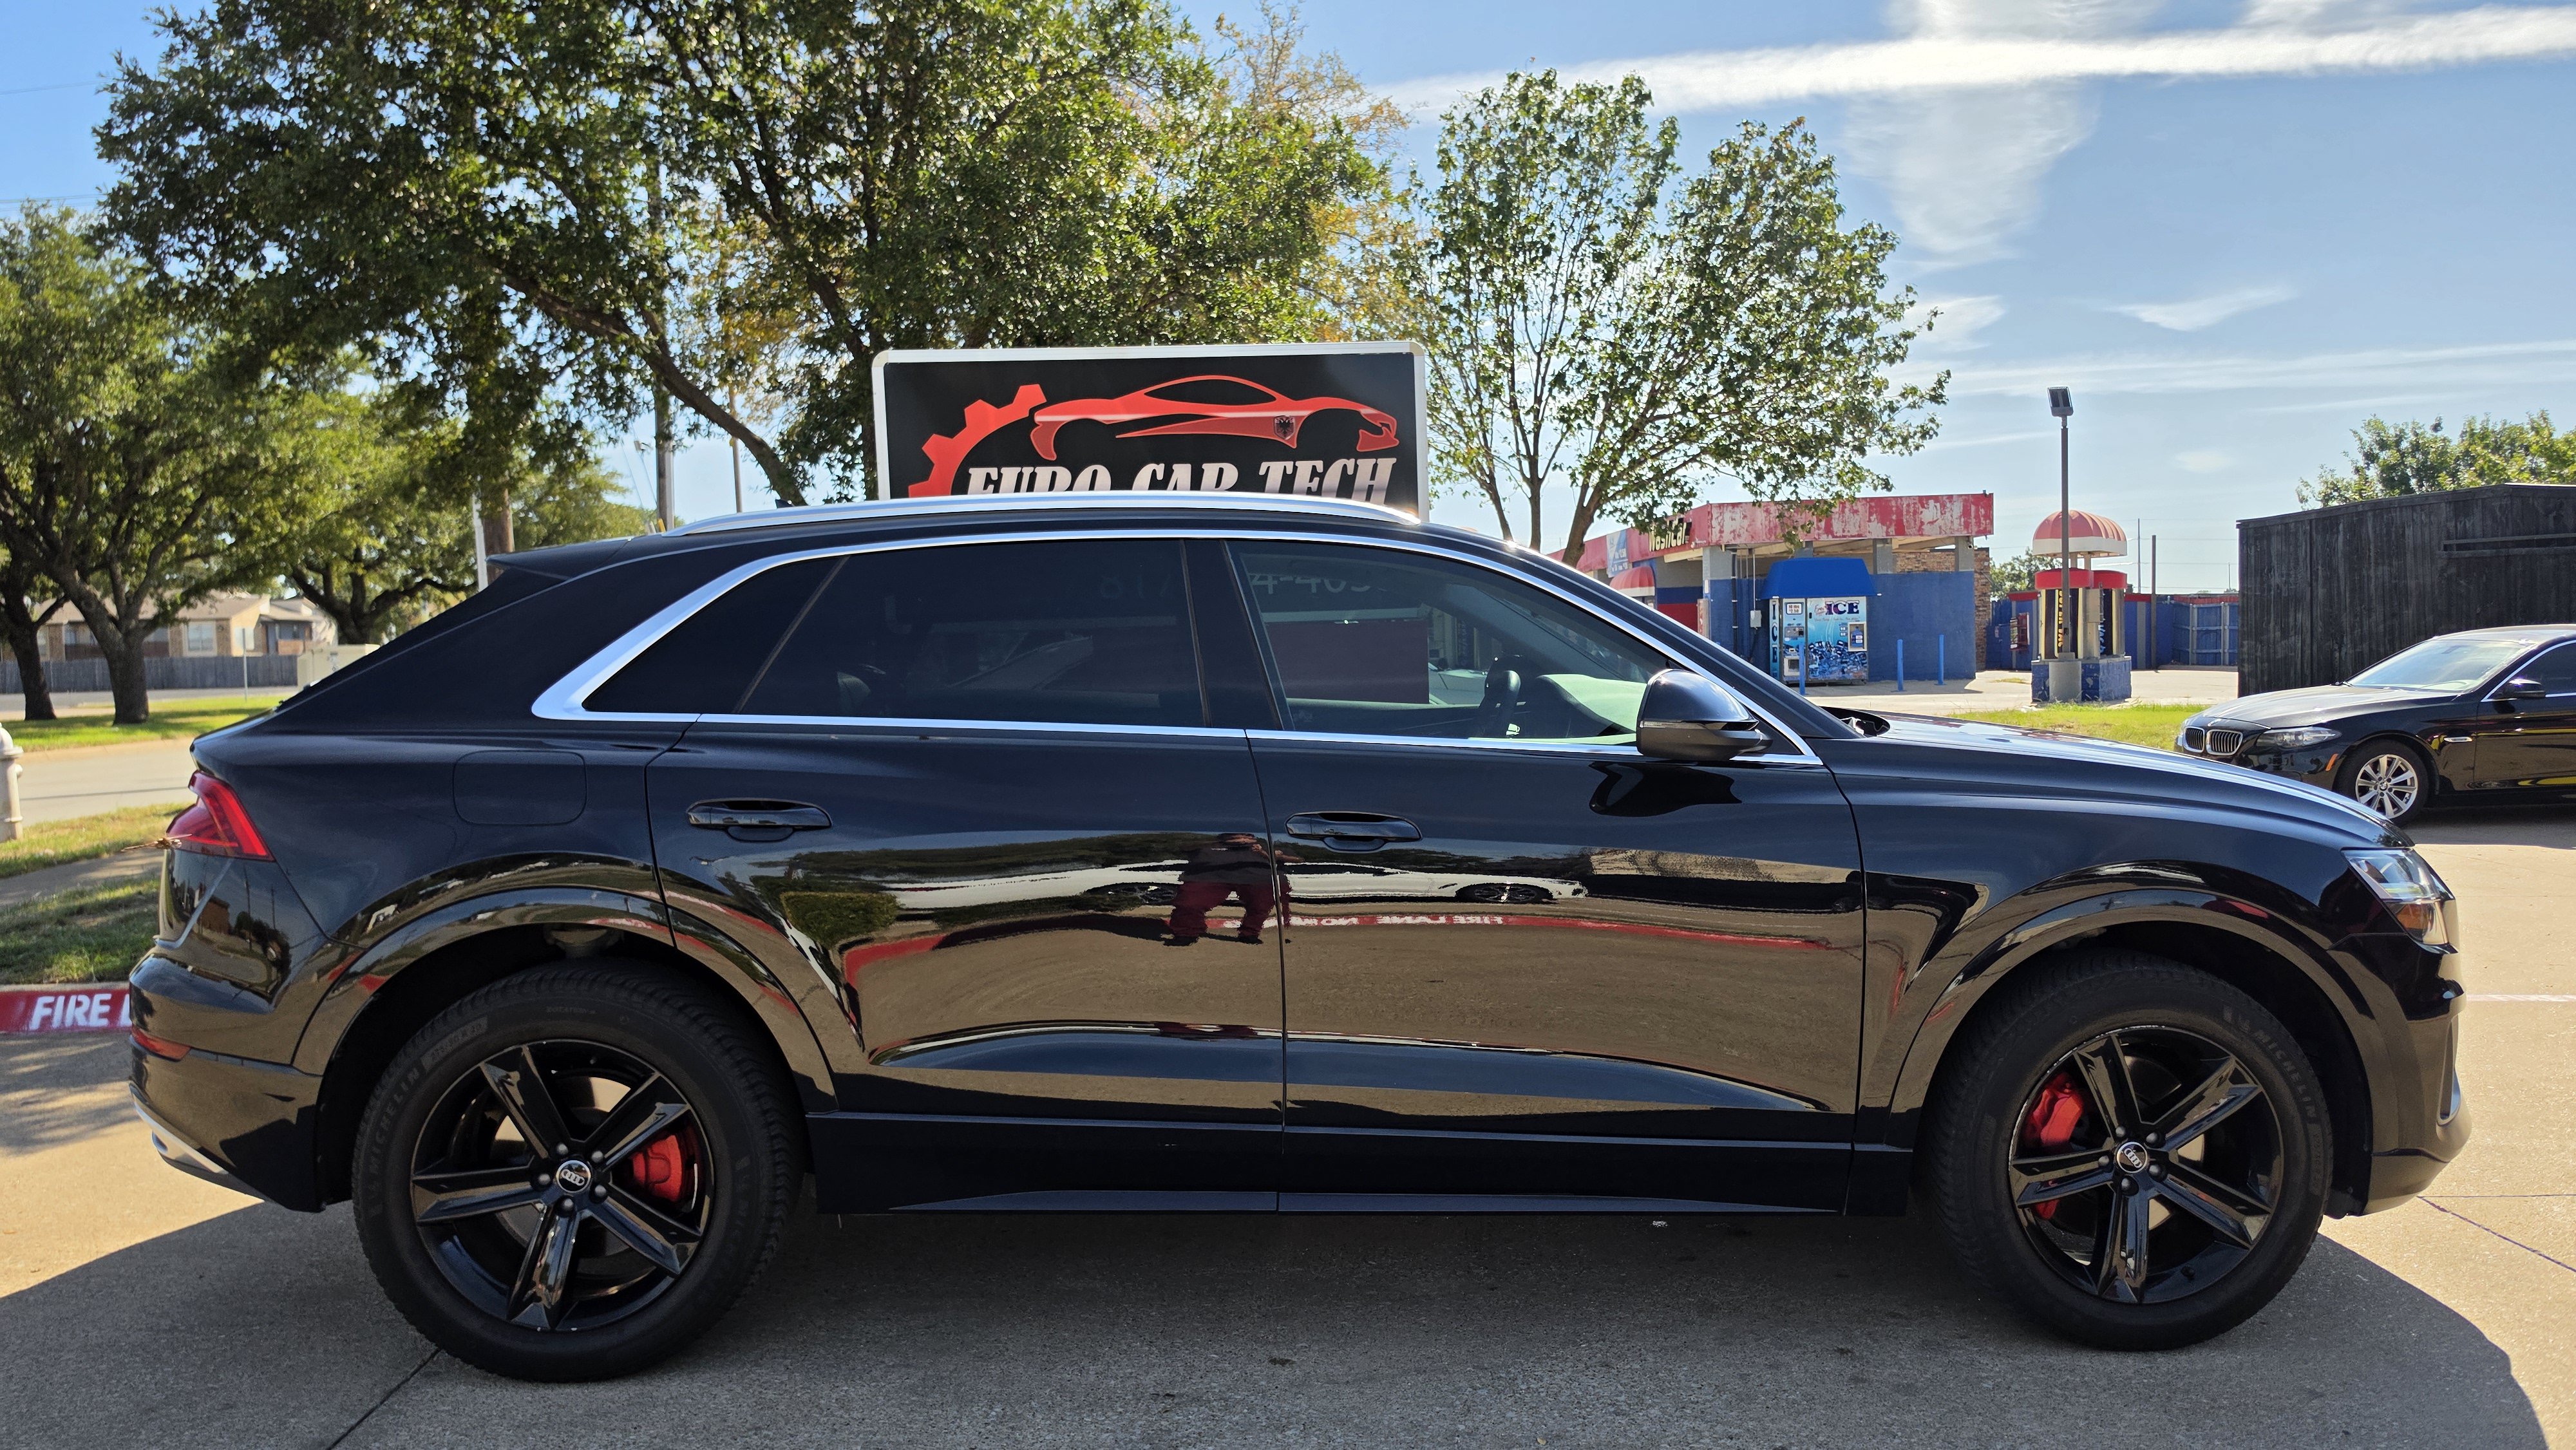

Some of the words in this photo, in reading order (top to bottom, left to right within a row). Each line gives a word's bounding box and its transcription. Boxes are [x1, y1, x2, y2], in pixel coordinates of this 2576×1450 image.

[1258, 458, 1397, 505] TECH
[1825, 600, 1860, 616] ICE
[30, 993, 112, 1030] FIRE
[2253, 1029, 2317, 1119] MICHELIN
[367, 1068, 419, 1172] MICHELIN
